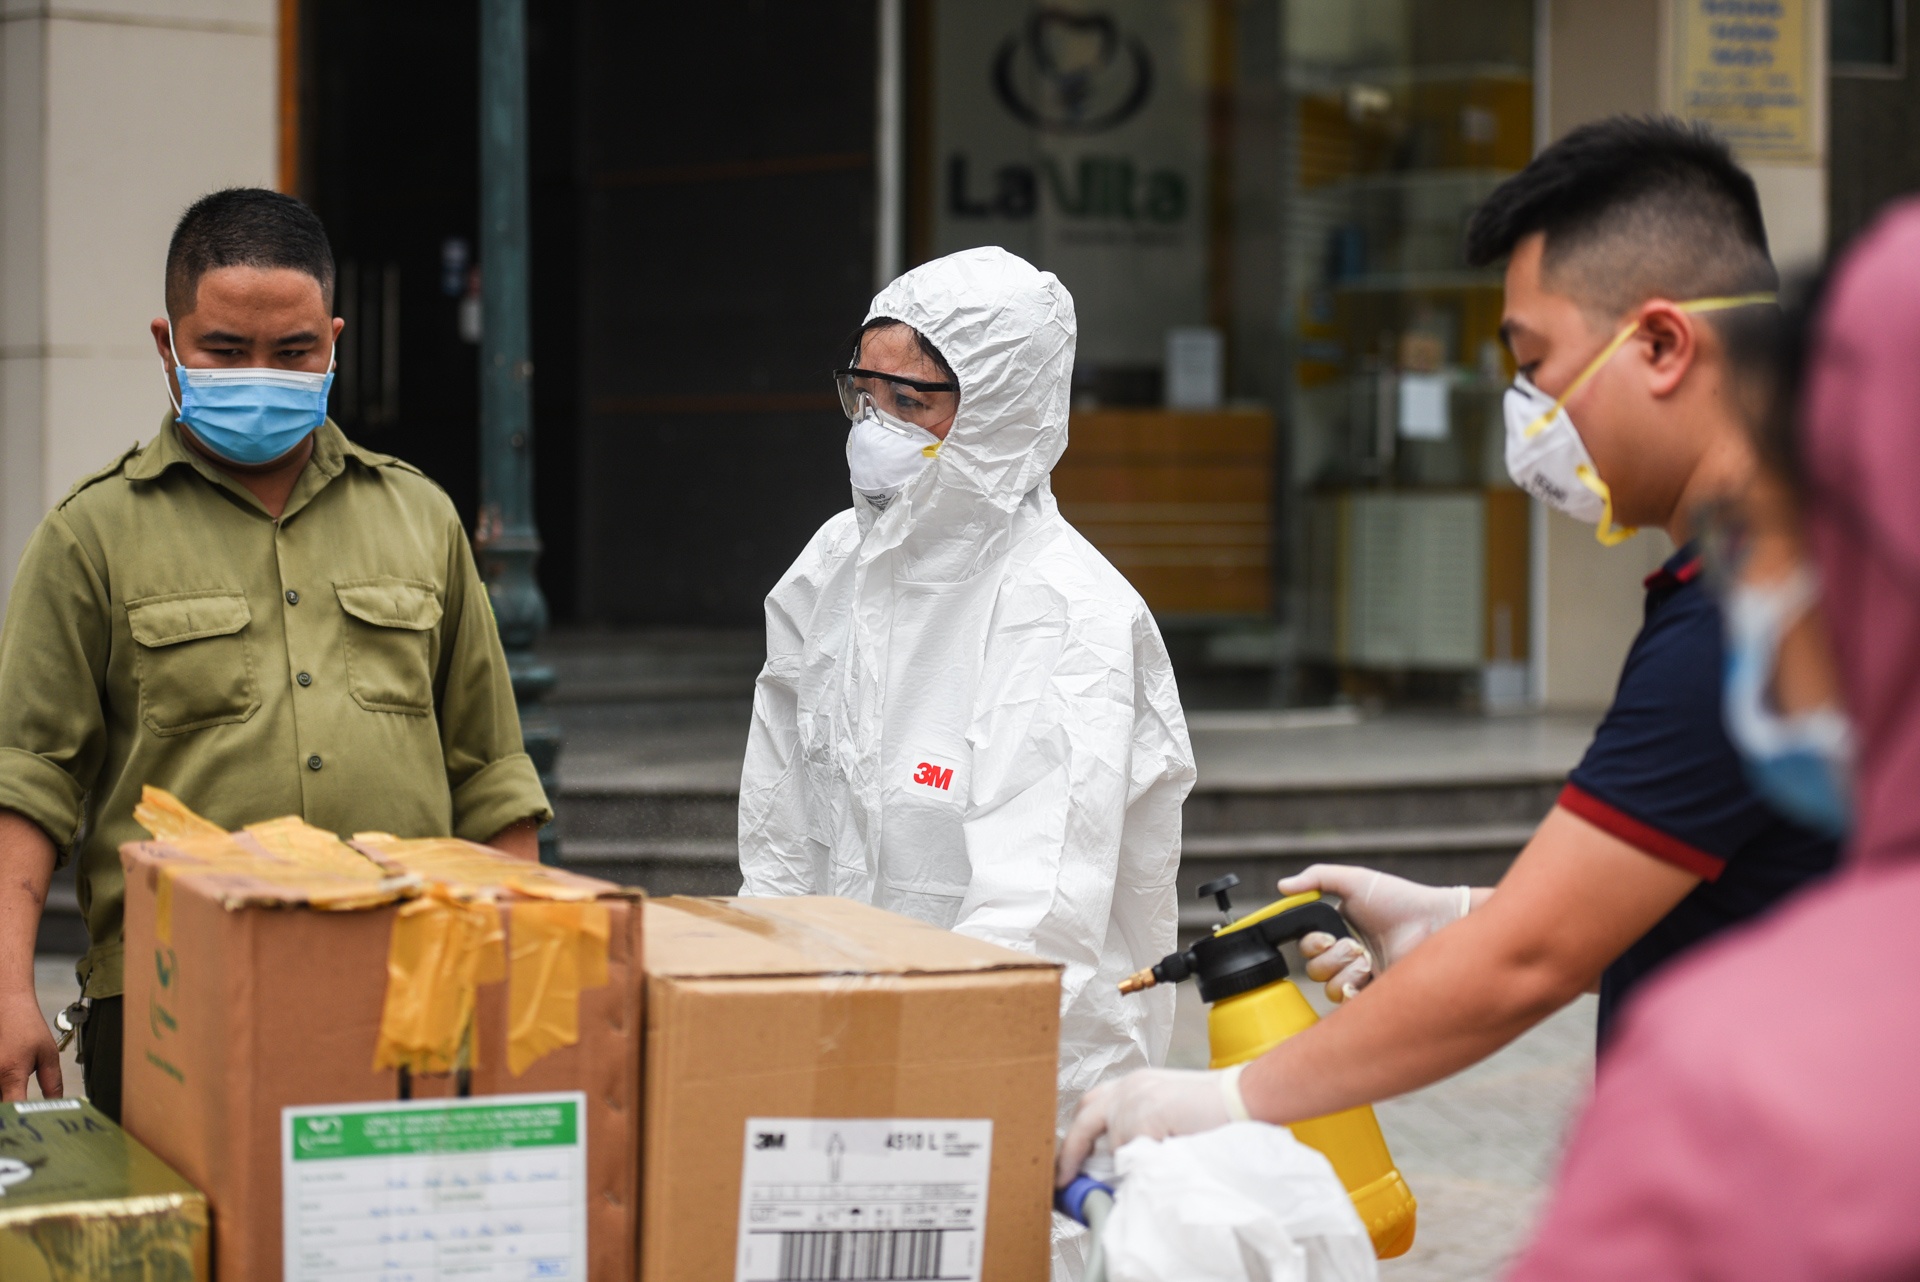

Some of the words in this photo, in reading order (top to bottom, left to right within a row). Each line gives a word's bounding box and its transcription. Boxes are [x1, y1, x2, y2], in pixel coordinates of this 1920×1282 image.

[913, 762, 954, 791] 3M
[754, 1133, 786, 1150] 3M
[884, 1132, 925, 1151] 4510
